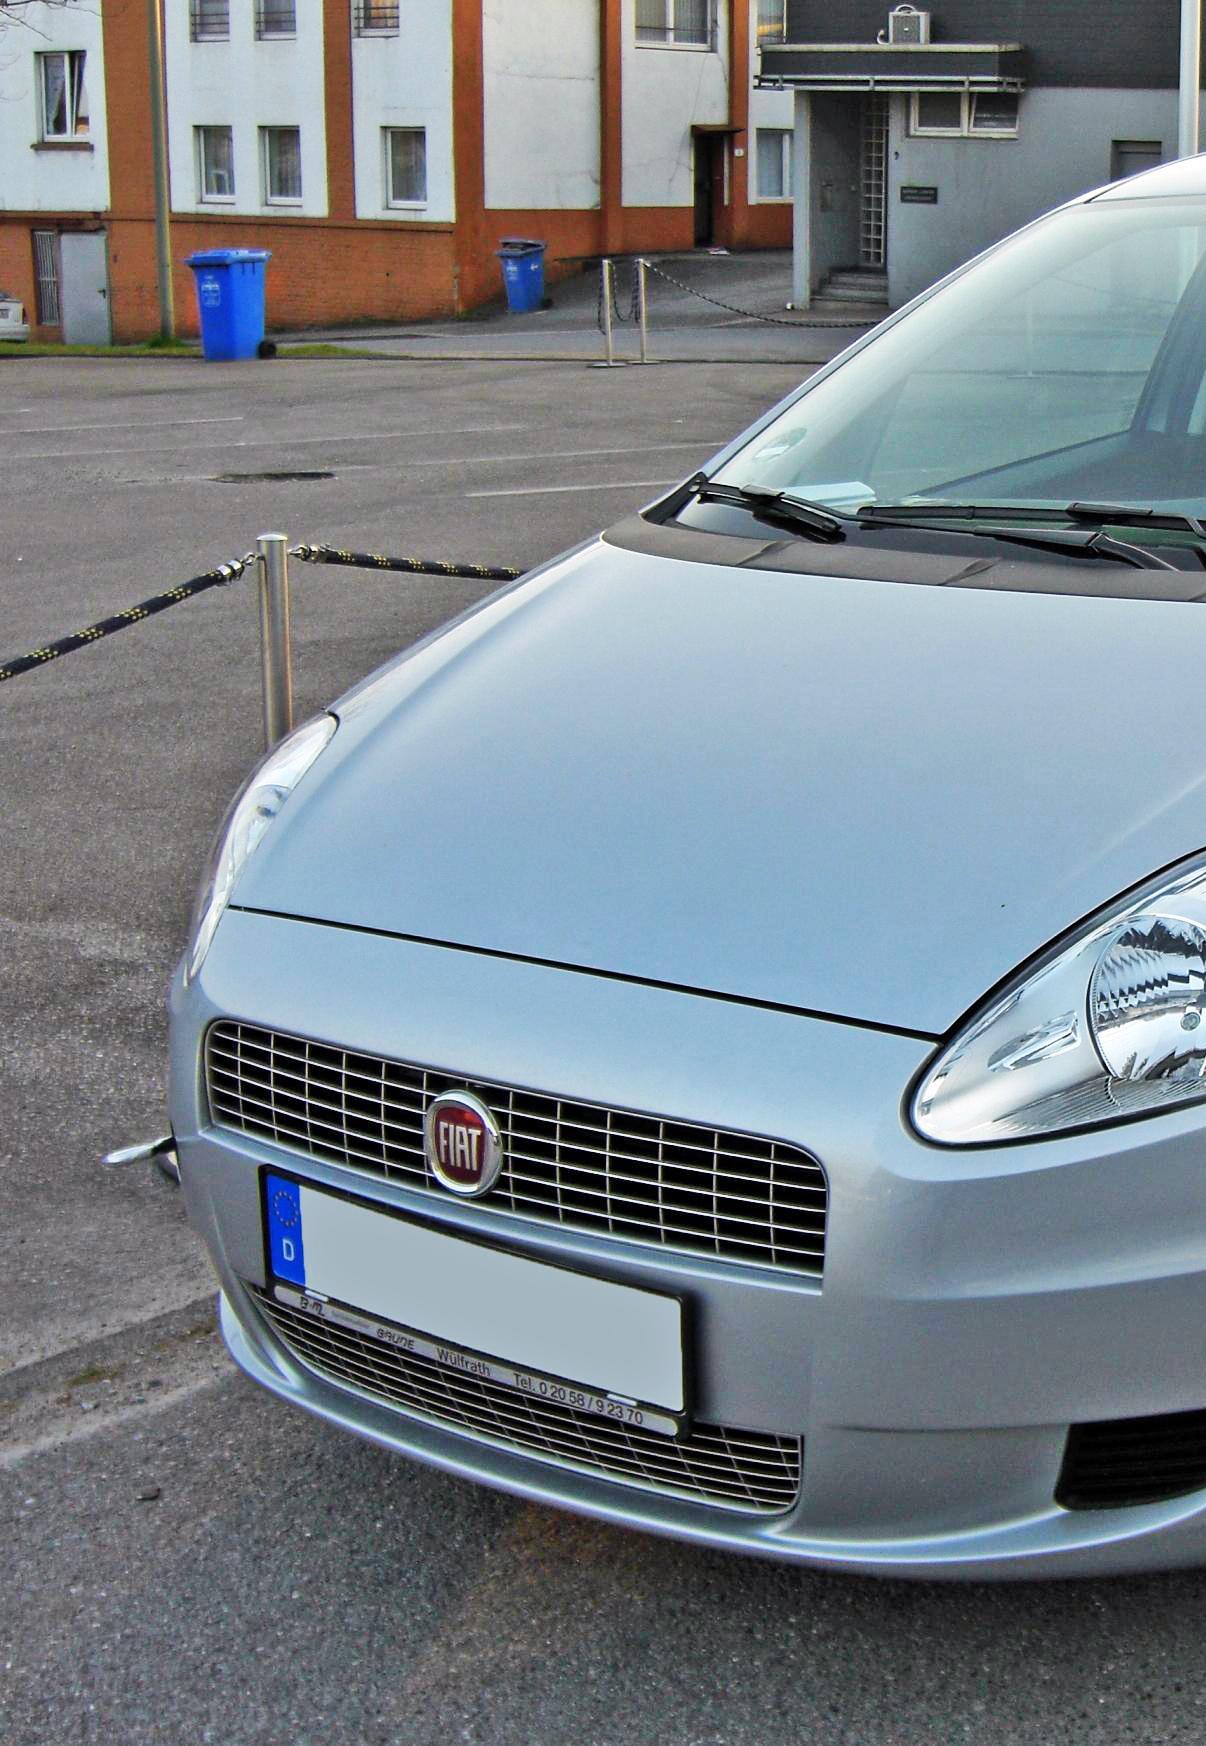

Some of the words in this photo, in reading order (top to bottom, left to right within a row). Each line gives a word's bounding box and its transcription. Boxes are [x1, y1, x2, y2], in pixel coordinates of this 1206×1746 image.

[439, 1121, 481, 1171] FIAT
[282, 1237, 295, 1262] D
[437, 1347, 491, 1377] Wülfrath
[513, 1373, 536, 1392] Tel.
